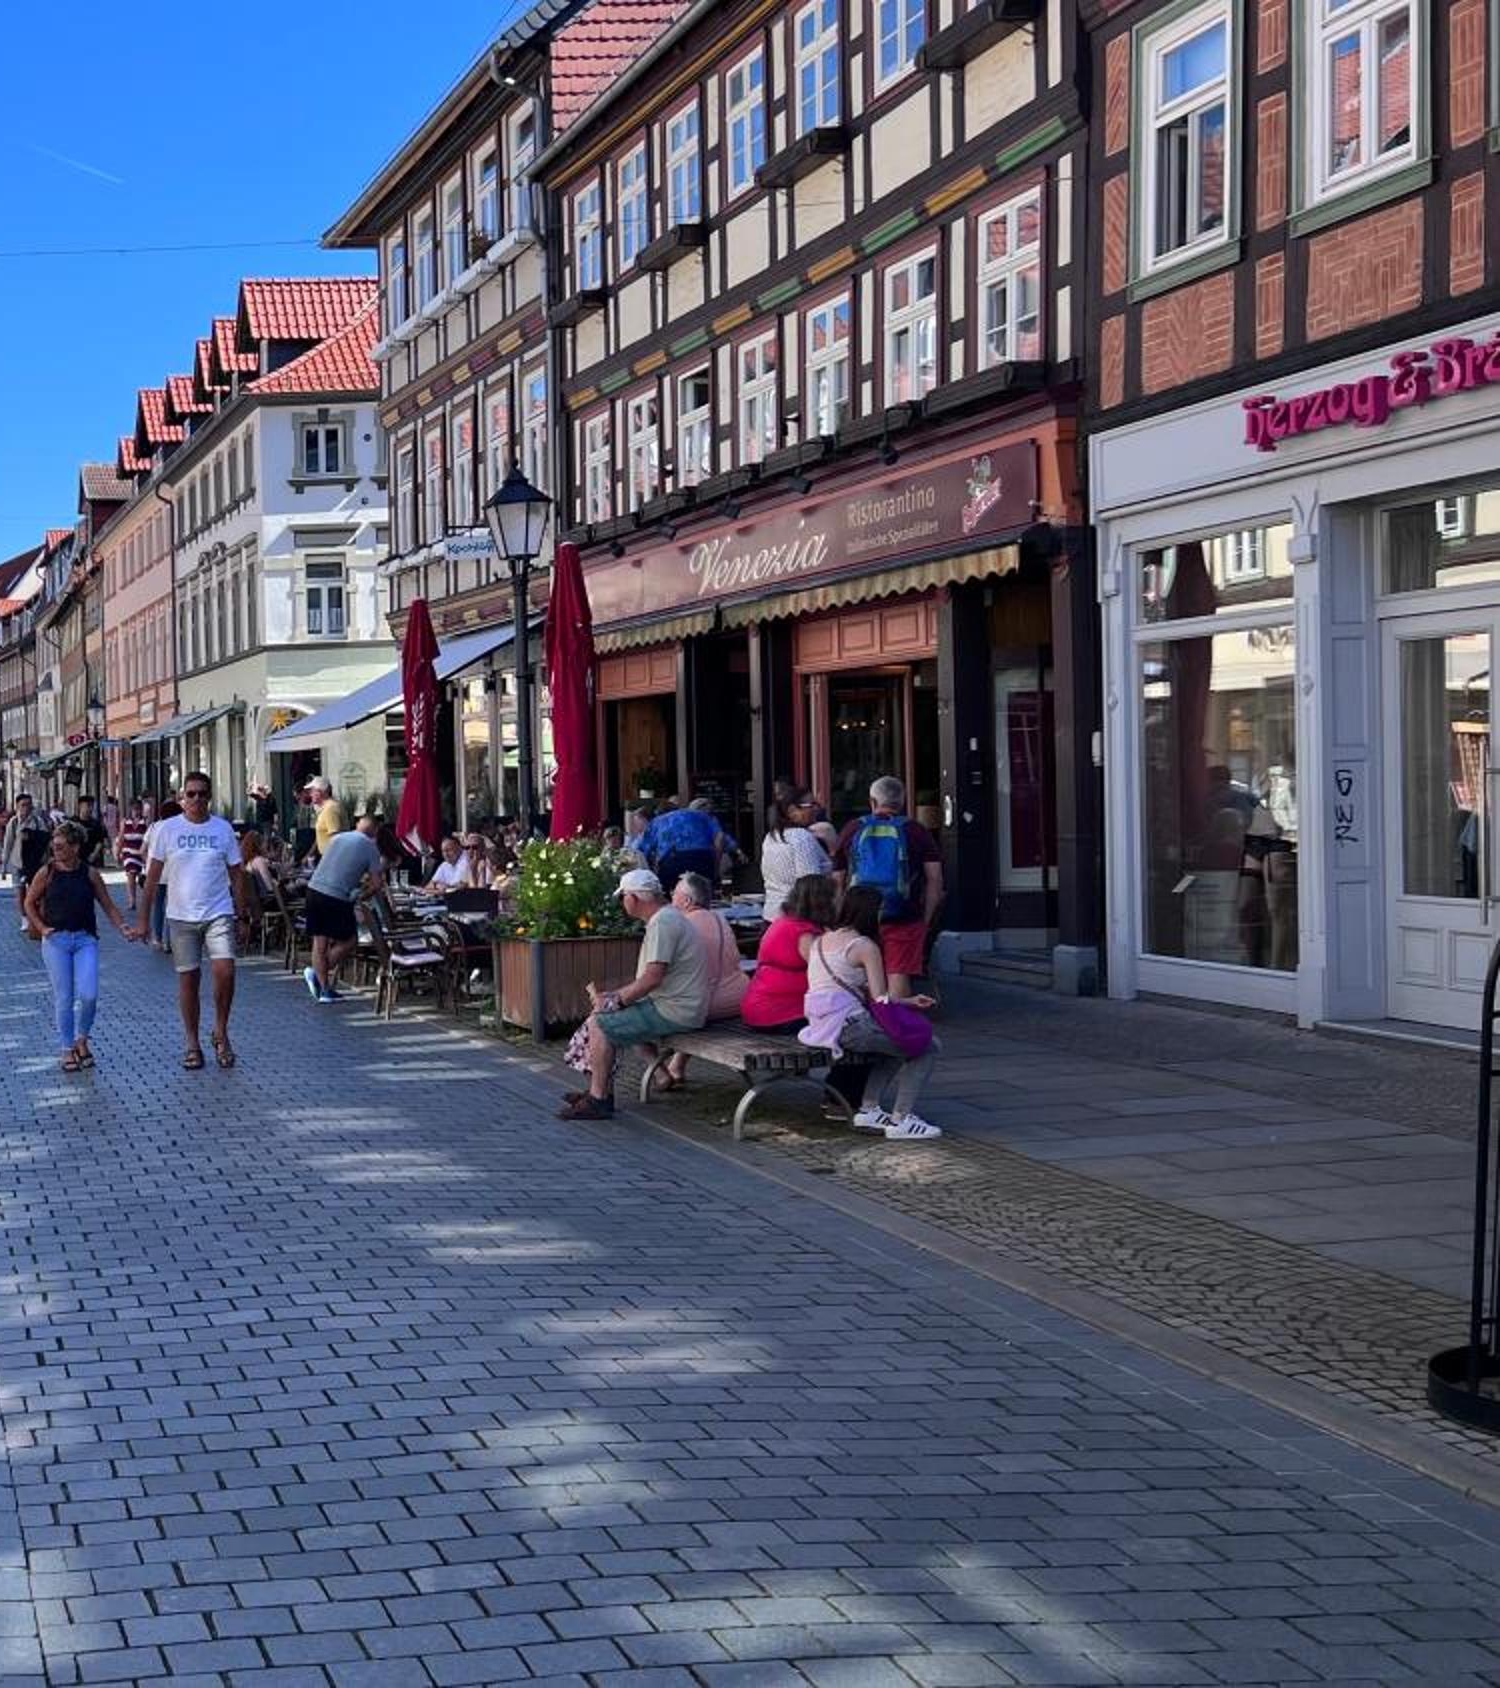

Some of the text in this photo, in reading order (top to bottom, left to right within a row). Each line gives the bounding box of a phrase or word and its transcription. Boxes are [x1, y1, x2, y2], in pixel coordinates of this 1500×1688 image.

[1388, 351, 1432, 408] &
[847, 485, 935, 528] Ristorantino
[689, 519, 829, 596] Venezia
[177, 834, 219, 849] CORE
